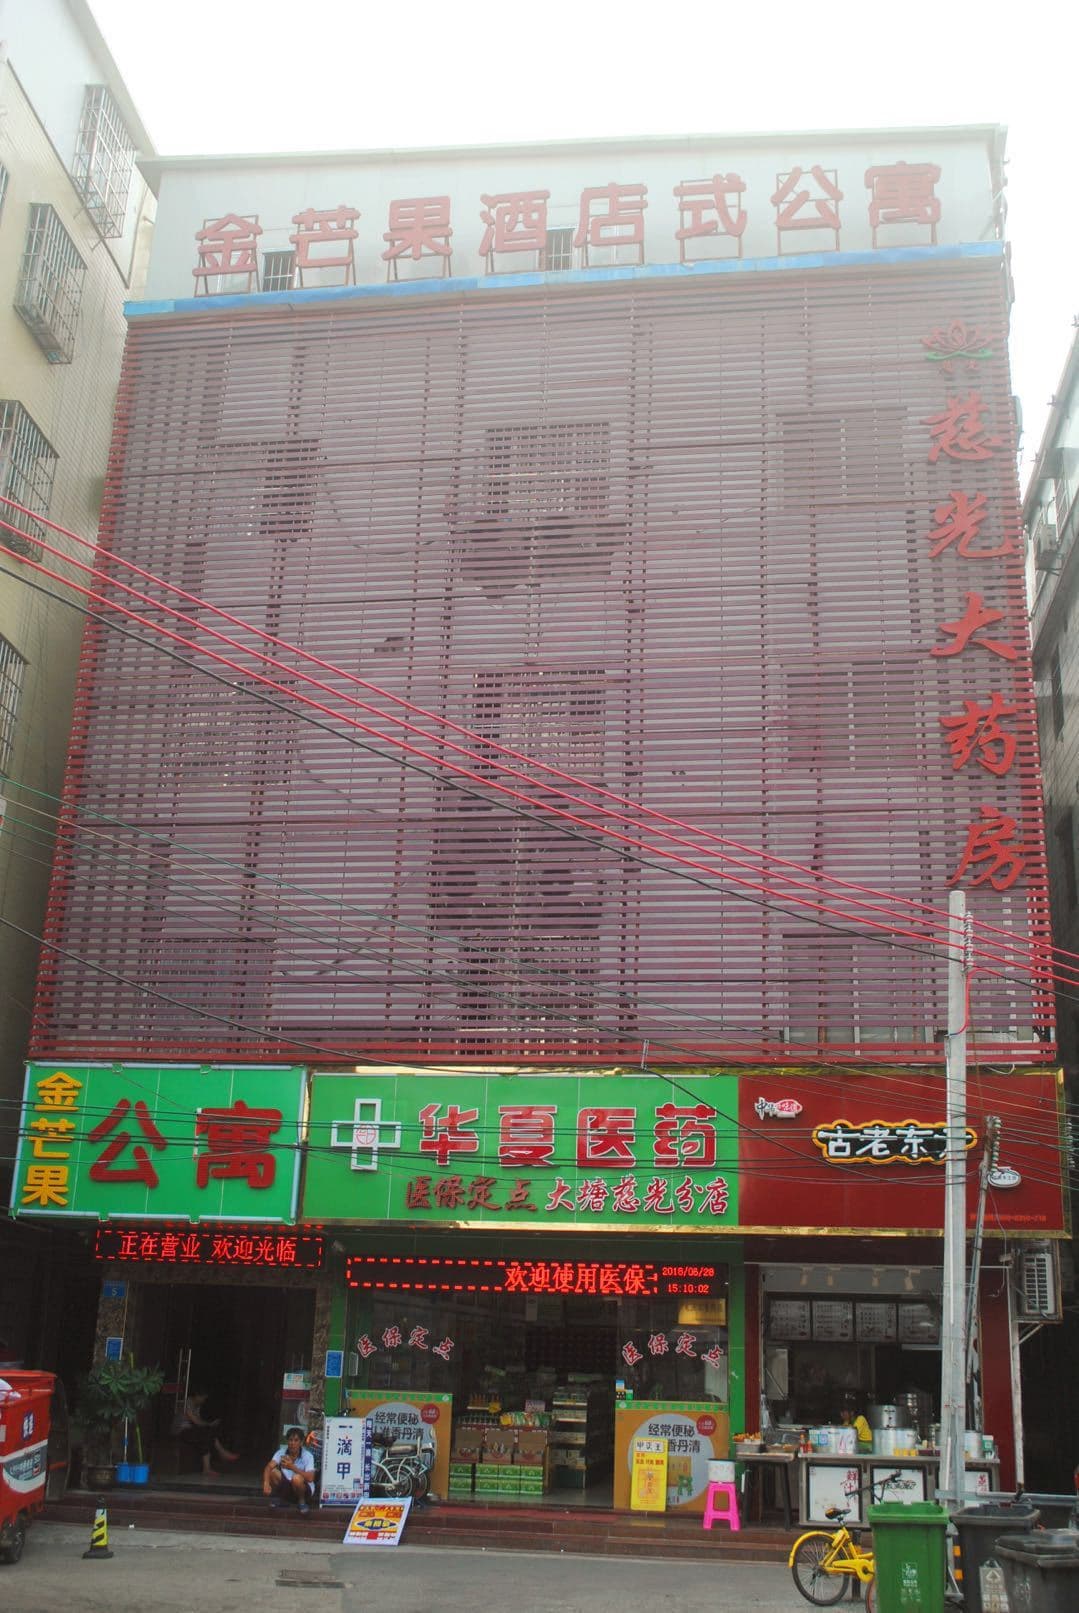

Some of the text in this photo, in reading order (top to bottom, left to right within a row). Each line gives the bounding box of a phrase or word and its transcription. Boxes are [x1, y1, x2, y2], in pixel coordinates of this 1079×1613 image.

[192, 161, 942, 276] 金芒果酒店式公寓
[927, 391, 1029, 891] 慈光大药房
[21, 1071, 83, 1207] 金芒果
[88, 1098, 283, 1190] 公寓
[418, 1102, 717, 1168] 华夏医药
[405, 1174, 730, 1215] 医保定点 大塘慈光分店
[118, 1234, 297, 1263] 正在营业 欢迎光临
[504, 1265, 646, 1294] 欢迎使用医保
[357, 1325, 455, 1360] 医保定点
[622, 1332, 725, 1368] 医保定点
[375, 1410, 419, 1426] 经常便秘
[648, 1423, 695, 1437] 经常便秘
